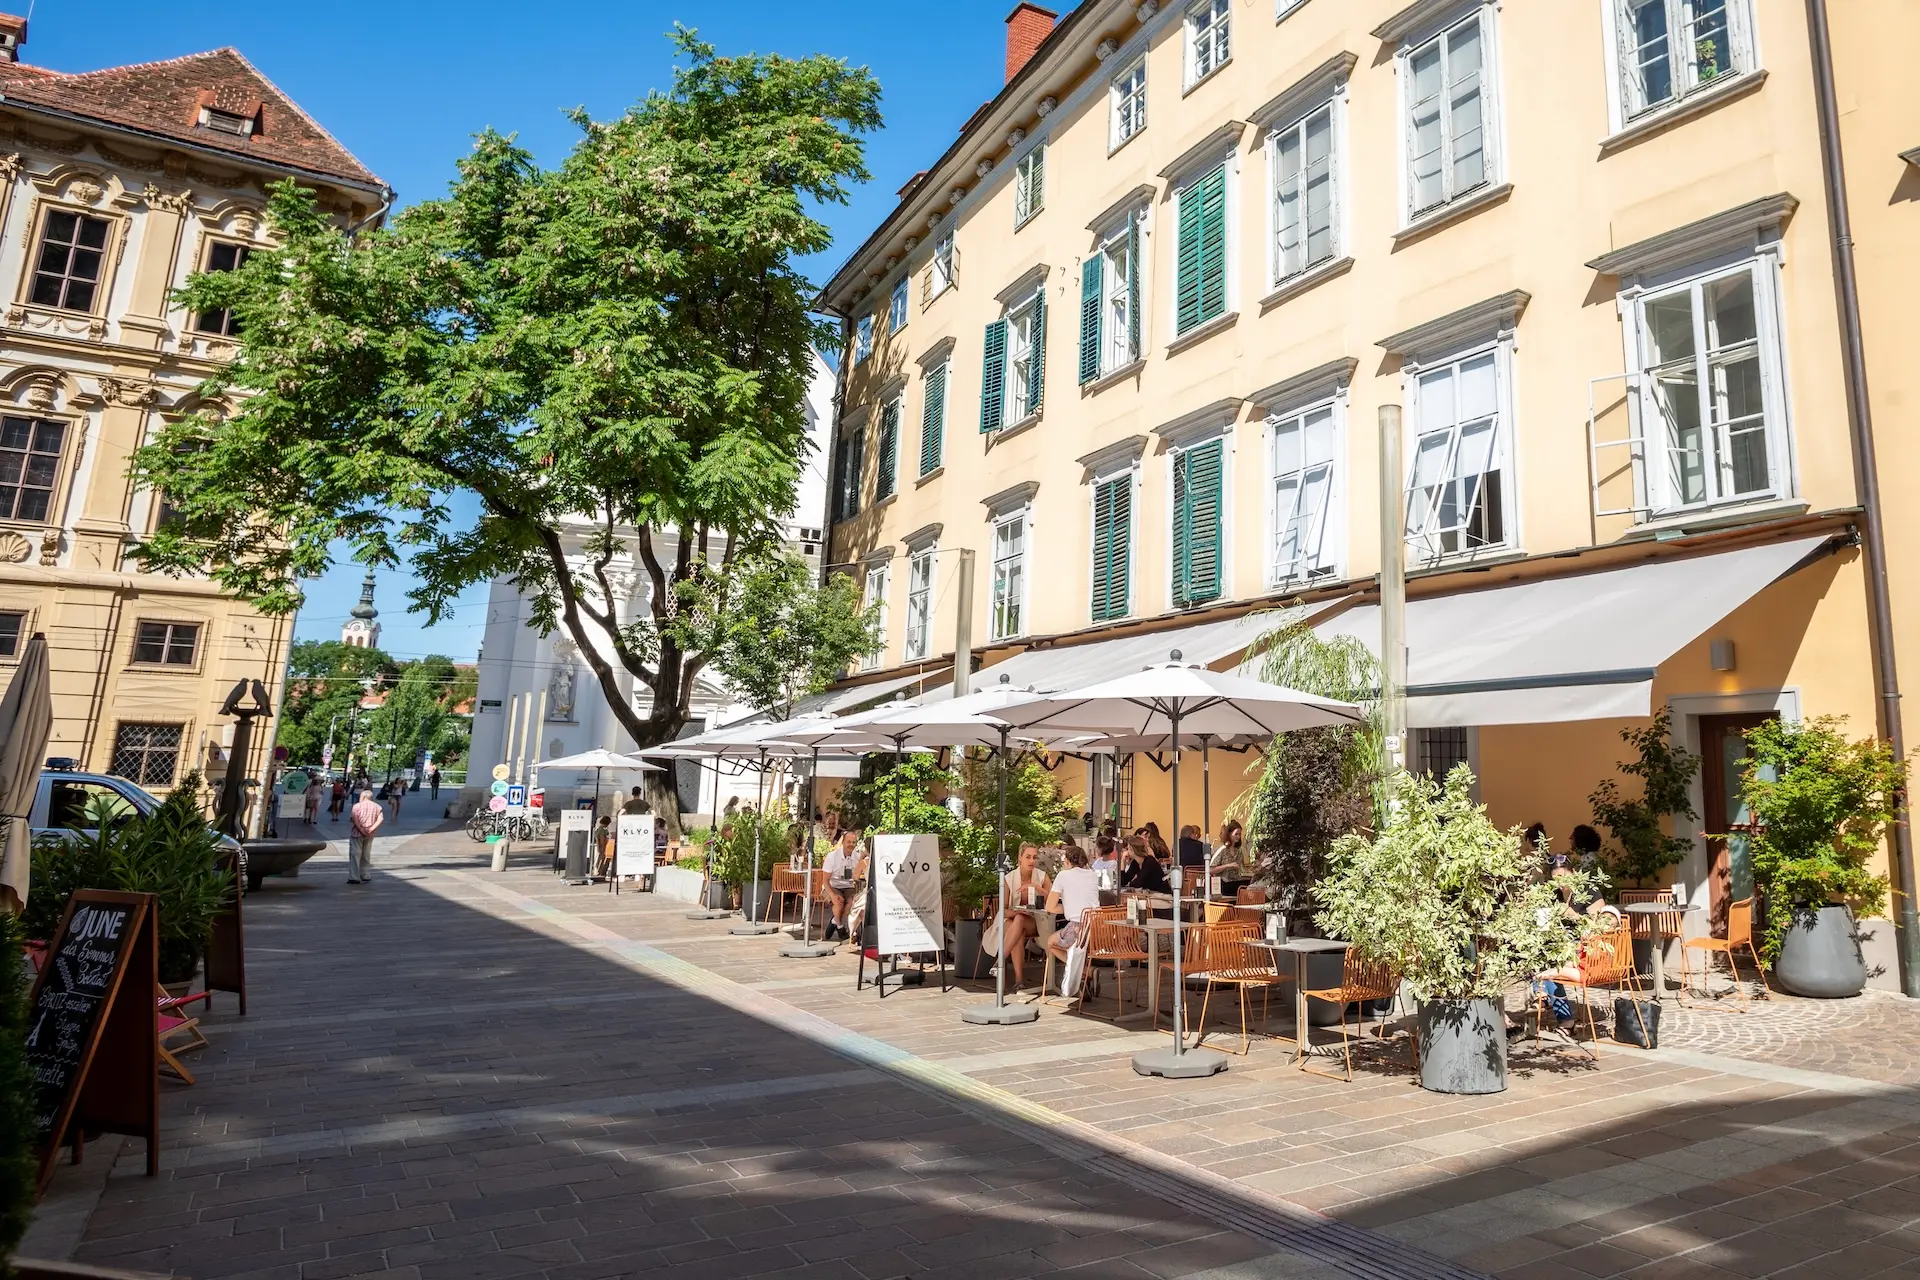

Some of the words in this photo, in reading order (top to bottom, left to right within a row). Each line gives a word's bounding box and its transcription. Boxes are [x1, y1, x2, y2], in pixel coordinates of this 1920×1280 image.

[623, 828, 649, 836] KLYO
[886, 861, 930, 875] KLYO
[75, 909, 126, 941] JUNE
[77, 940, 116, 964] Sommer
